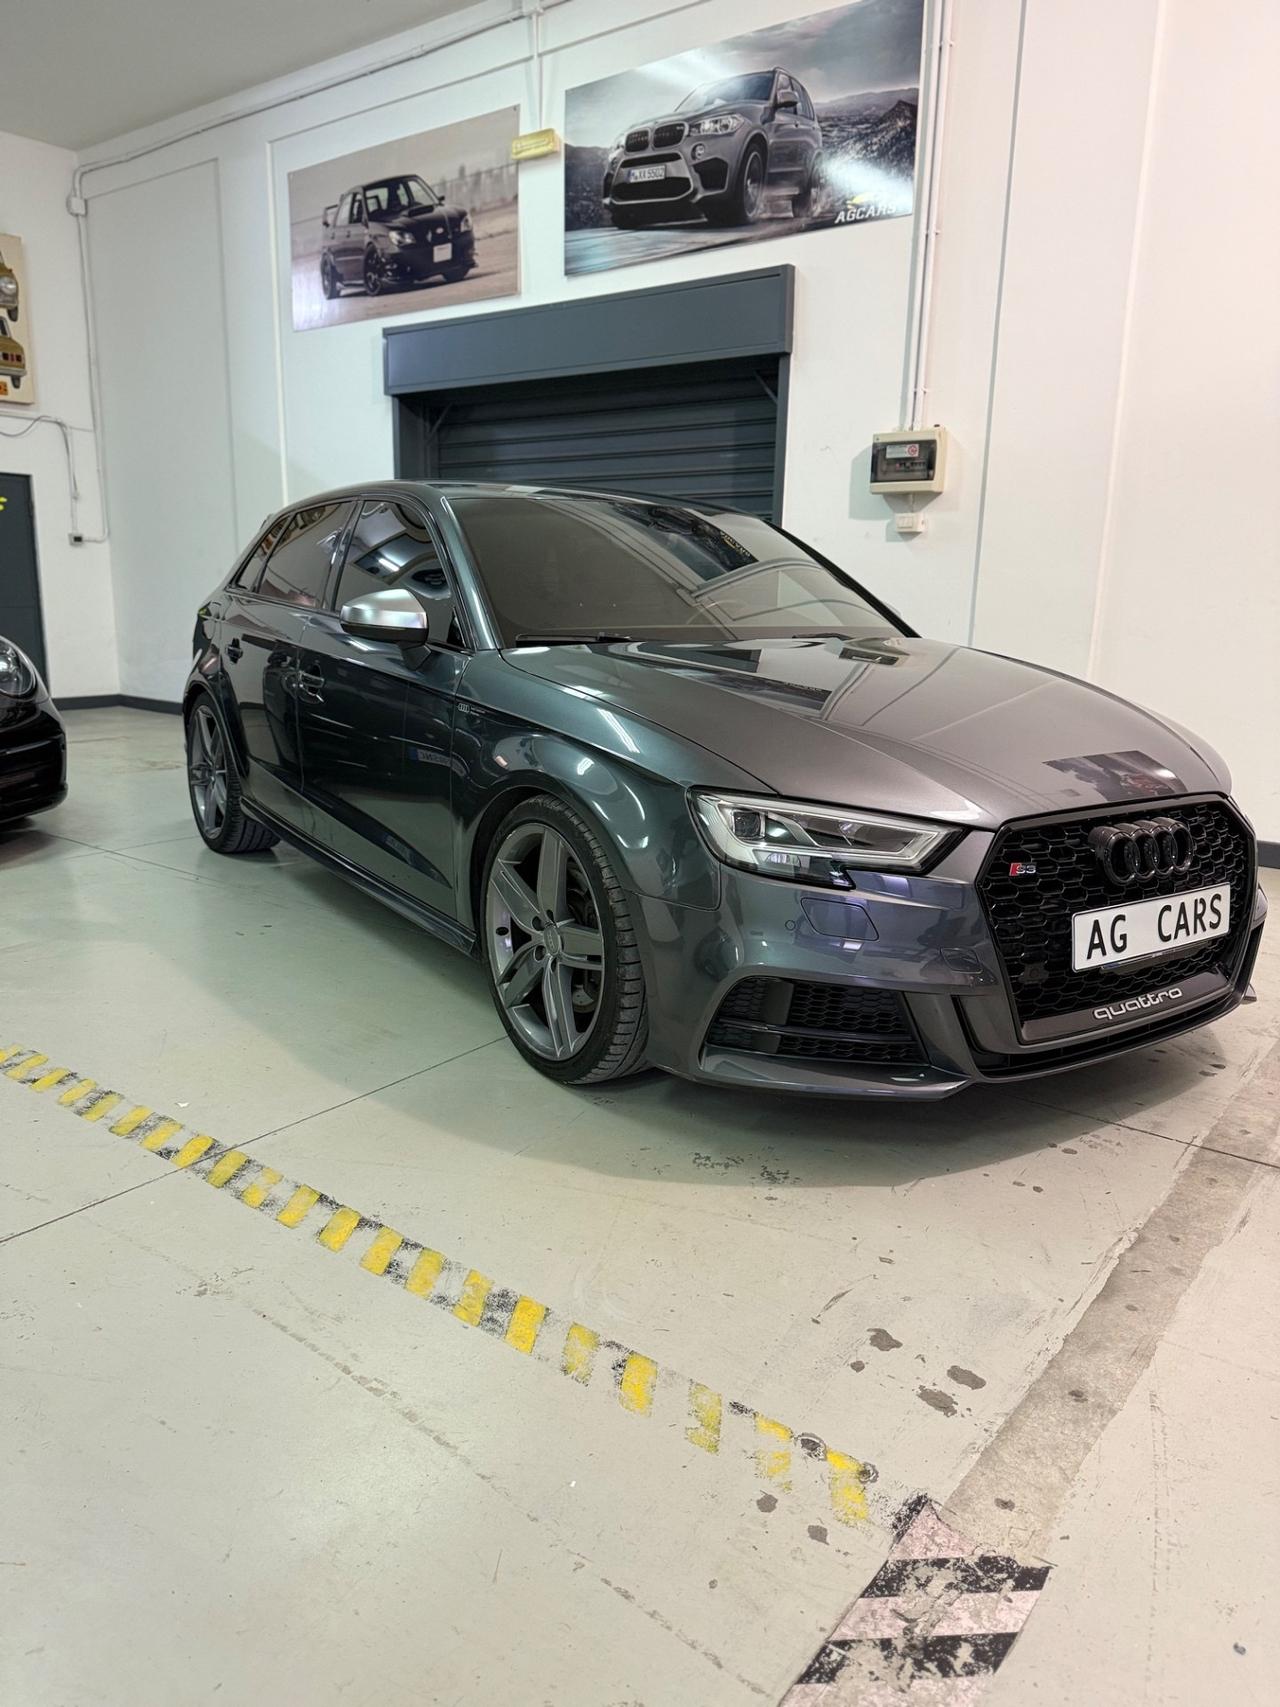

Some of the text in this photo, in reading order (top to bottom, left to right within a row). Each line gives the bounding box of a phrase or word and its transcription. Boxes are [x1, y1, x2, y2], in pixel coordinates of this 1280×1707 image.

[834, 203, 897, 224] AGCARS
[1086, 893, 1222, 961] AG CARS
[1093, 987, 1183, 1020] quattro
